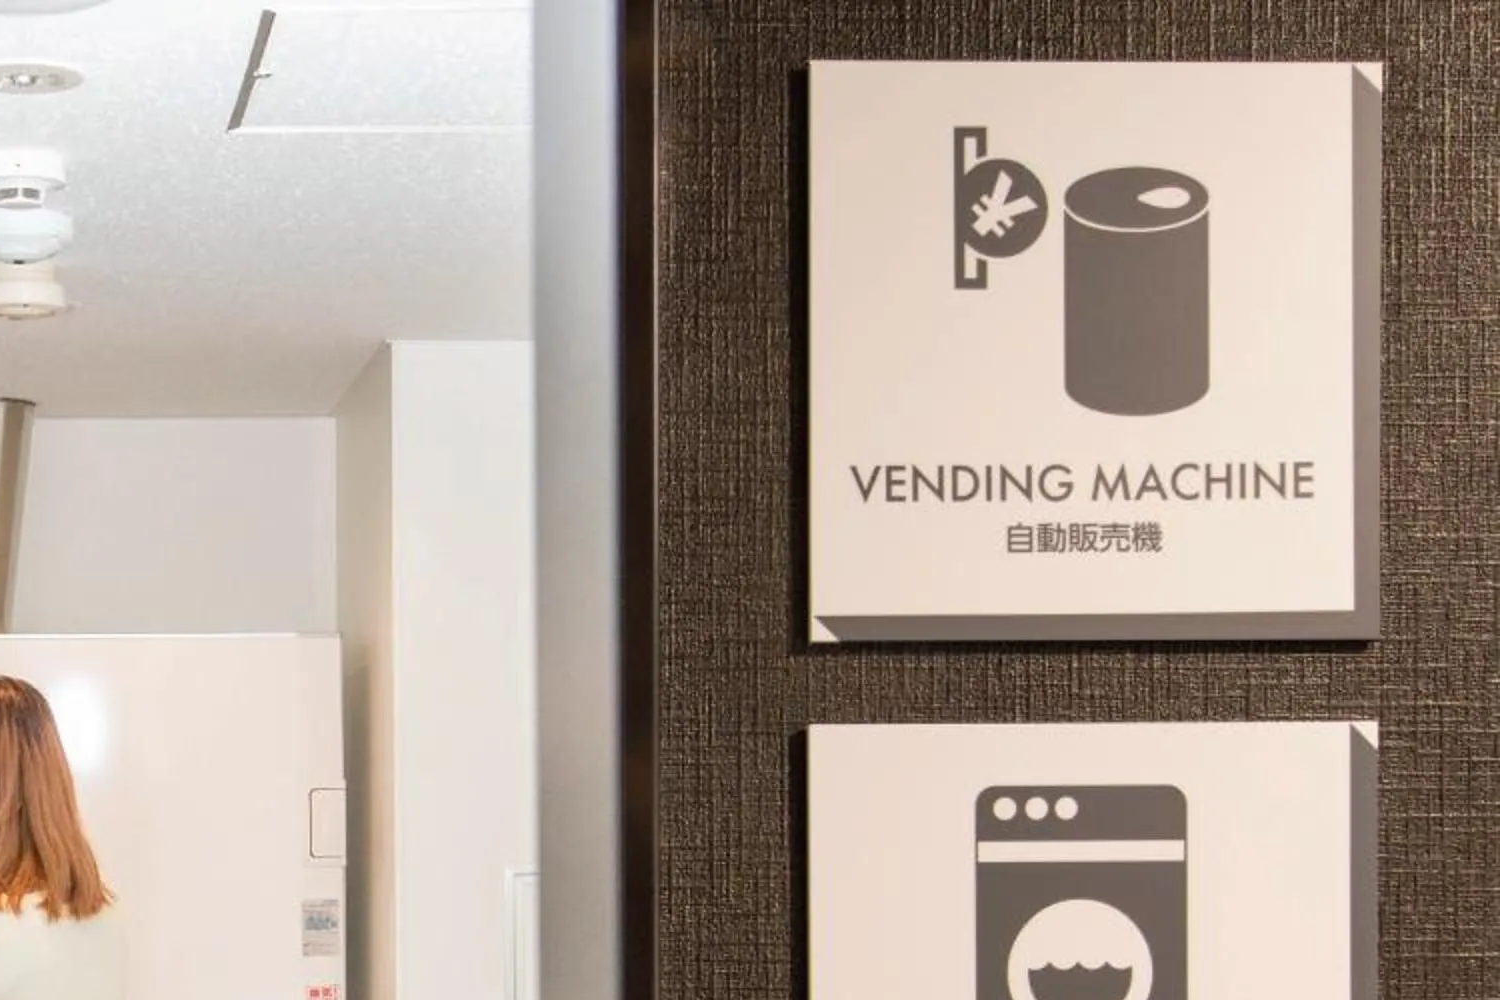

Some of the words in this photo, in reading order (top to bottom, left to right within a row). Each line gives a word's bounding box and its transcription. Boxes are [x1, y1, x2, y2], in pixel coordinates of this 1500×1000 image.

[849, 463, 1074, 503] VENDING
[1091, 461, 1315, 502] MACHINE
[1006, 522, 1163, 554] 自動販売機
